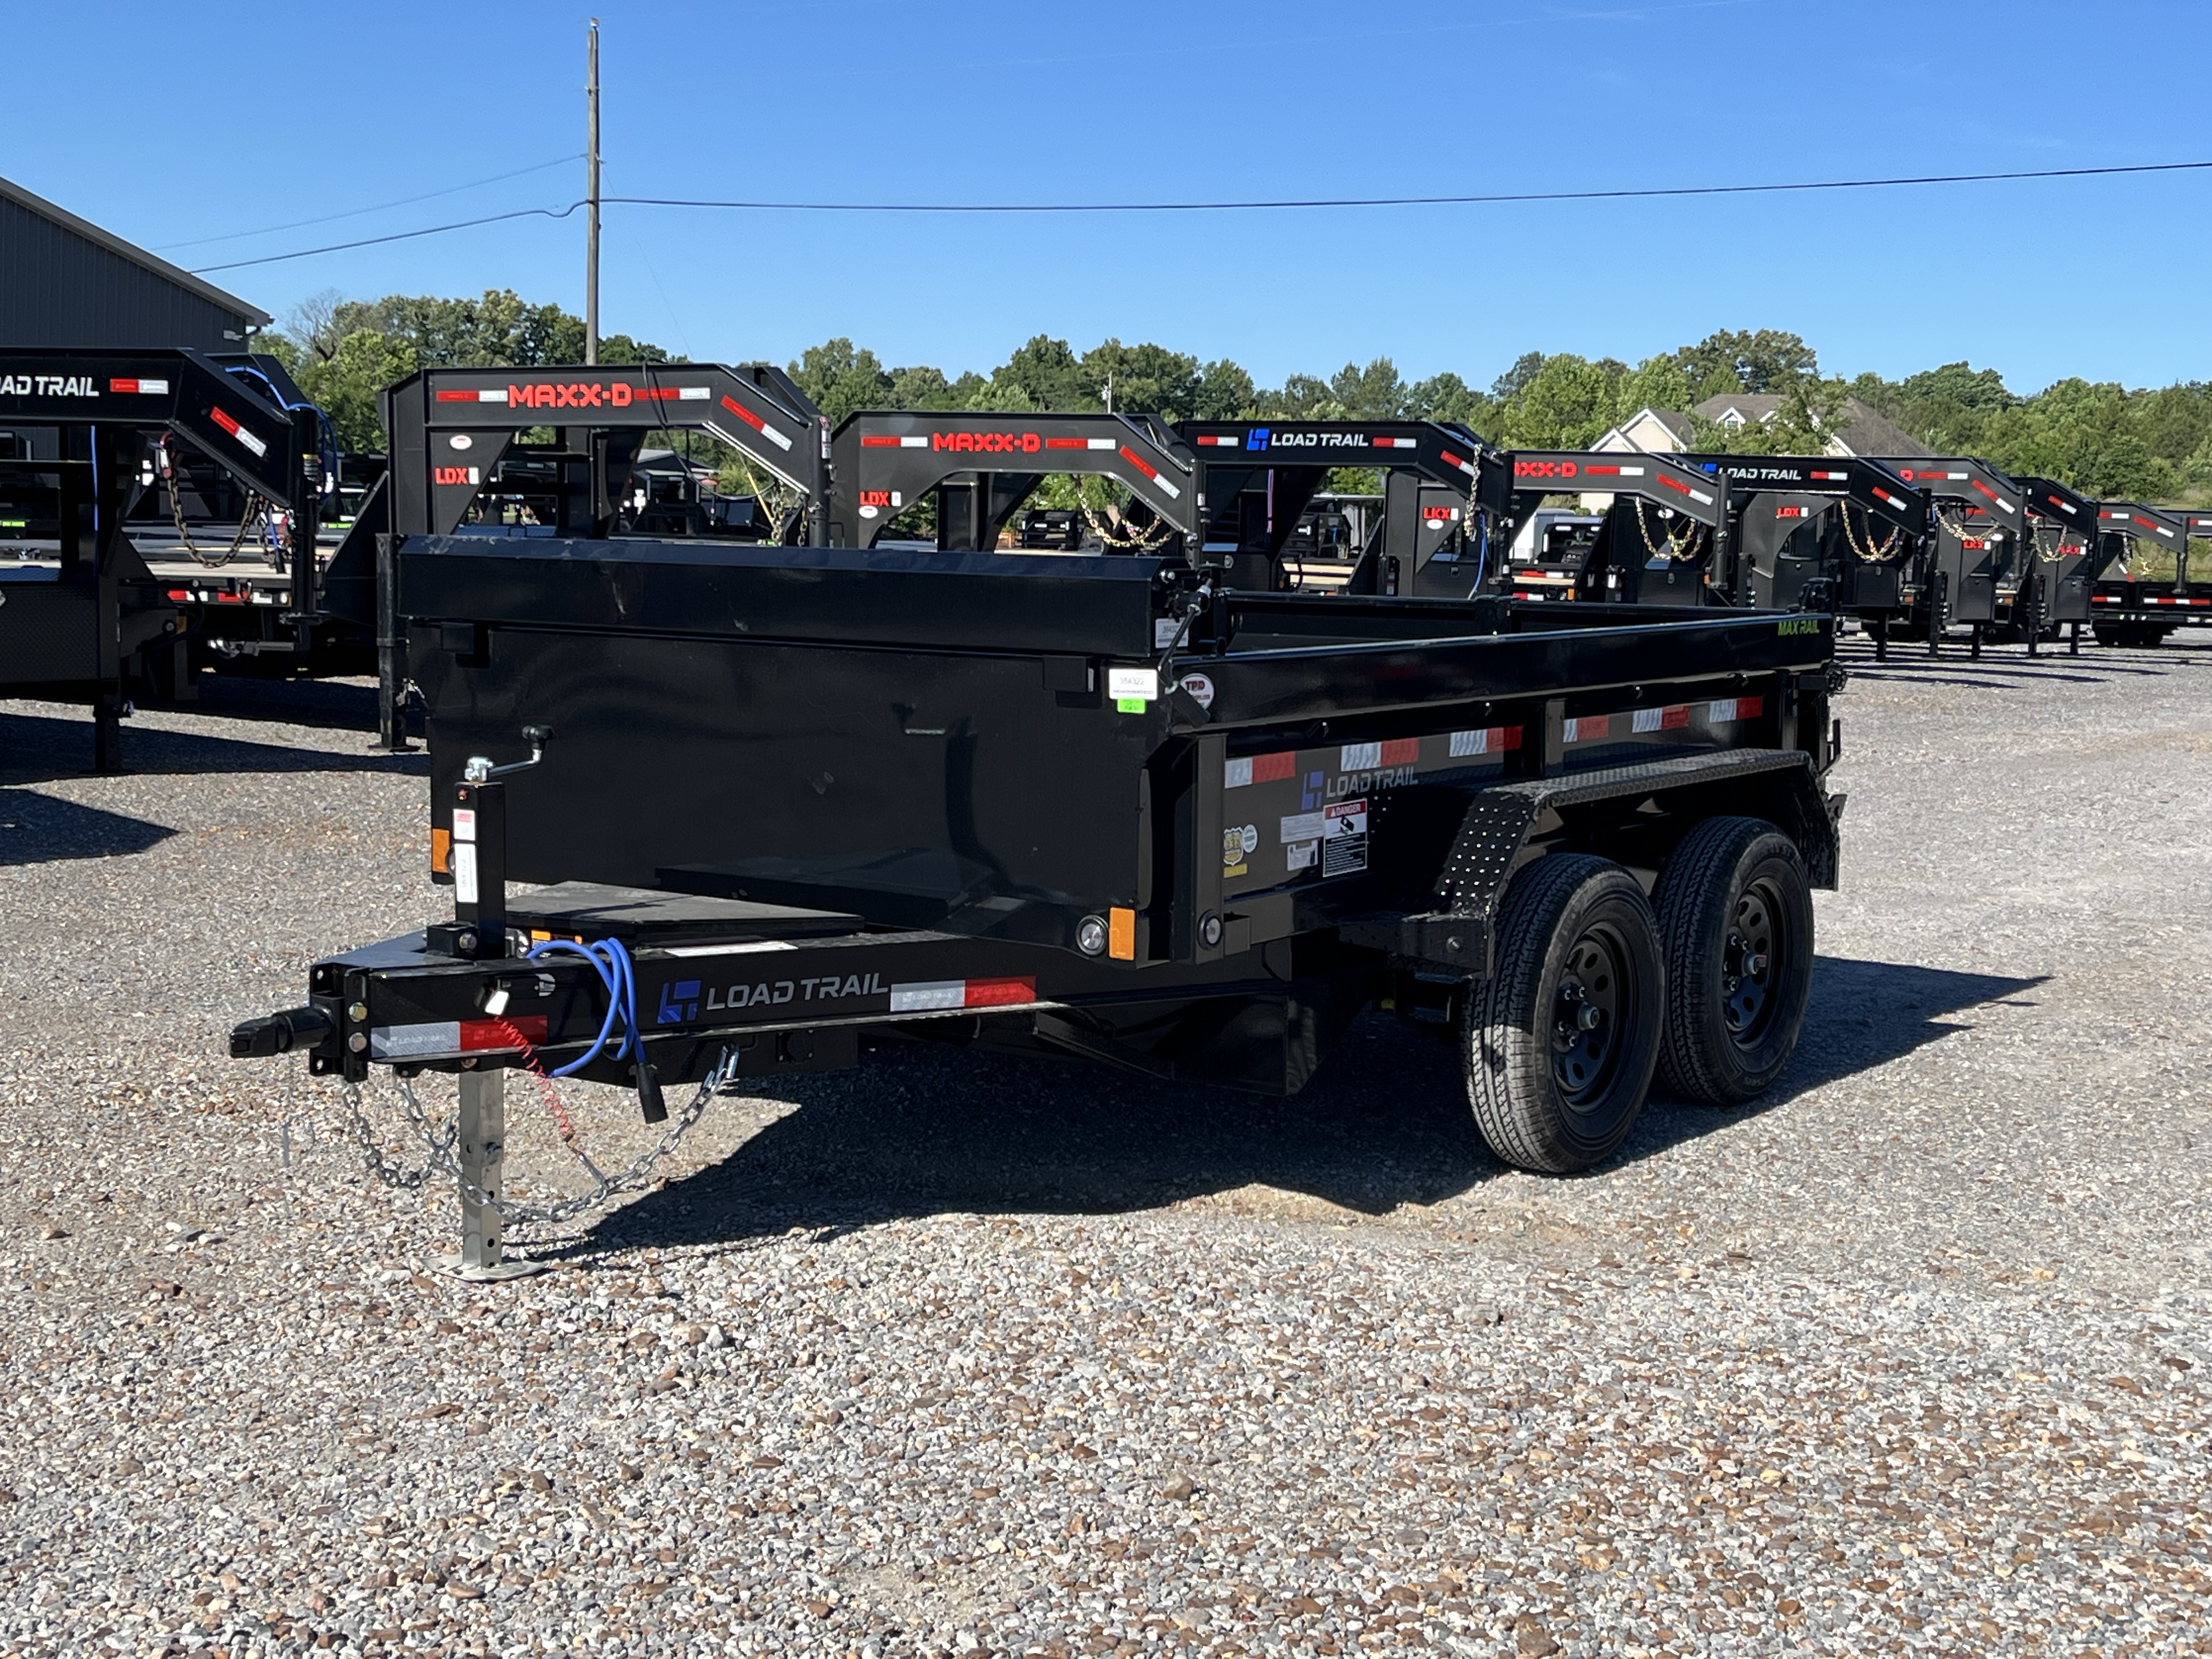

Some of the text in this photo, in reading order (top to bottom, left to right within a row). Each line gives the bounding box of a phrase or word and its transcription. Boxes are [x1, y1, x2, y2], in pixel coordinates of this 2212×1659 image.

[0, 375, 99, 397] AD TRAIL
[509, 383, 633, 408] MAXX-D
[933, 432, 1041, 454] MAXX-D
[1271, 433, 1369, 447] LOAD TRAIL
[435, 467, 468, 485] LDX
[1760, 469, 1802, 481] TRAIL
[859, 491, 890, 507] LDX
[1778, 619, 1820, 635] MAX RAIL
[1326, 766, 1419, 798] LOAD TRAIL
[1335, 803, 1361, 816] DANGER
[706, 973, 889, 1011] LOAD TRAIL
[398, 1036, 423, 1045] LOAD
